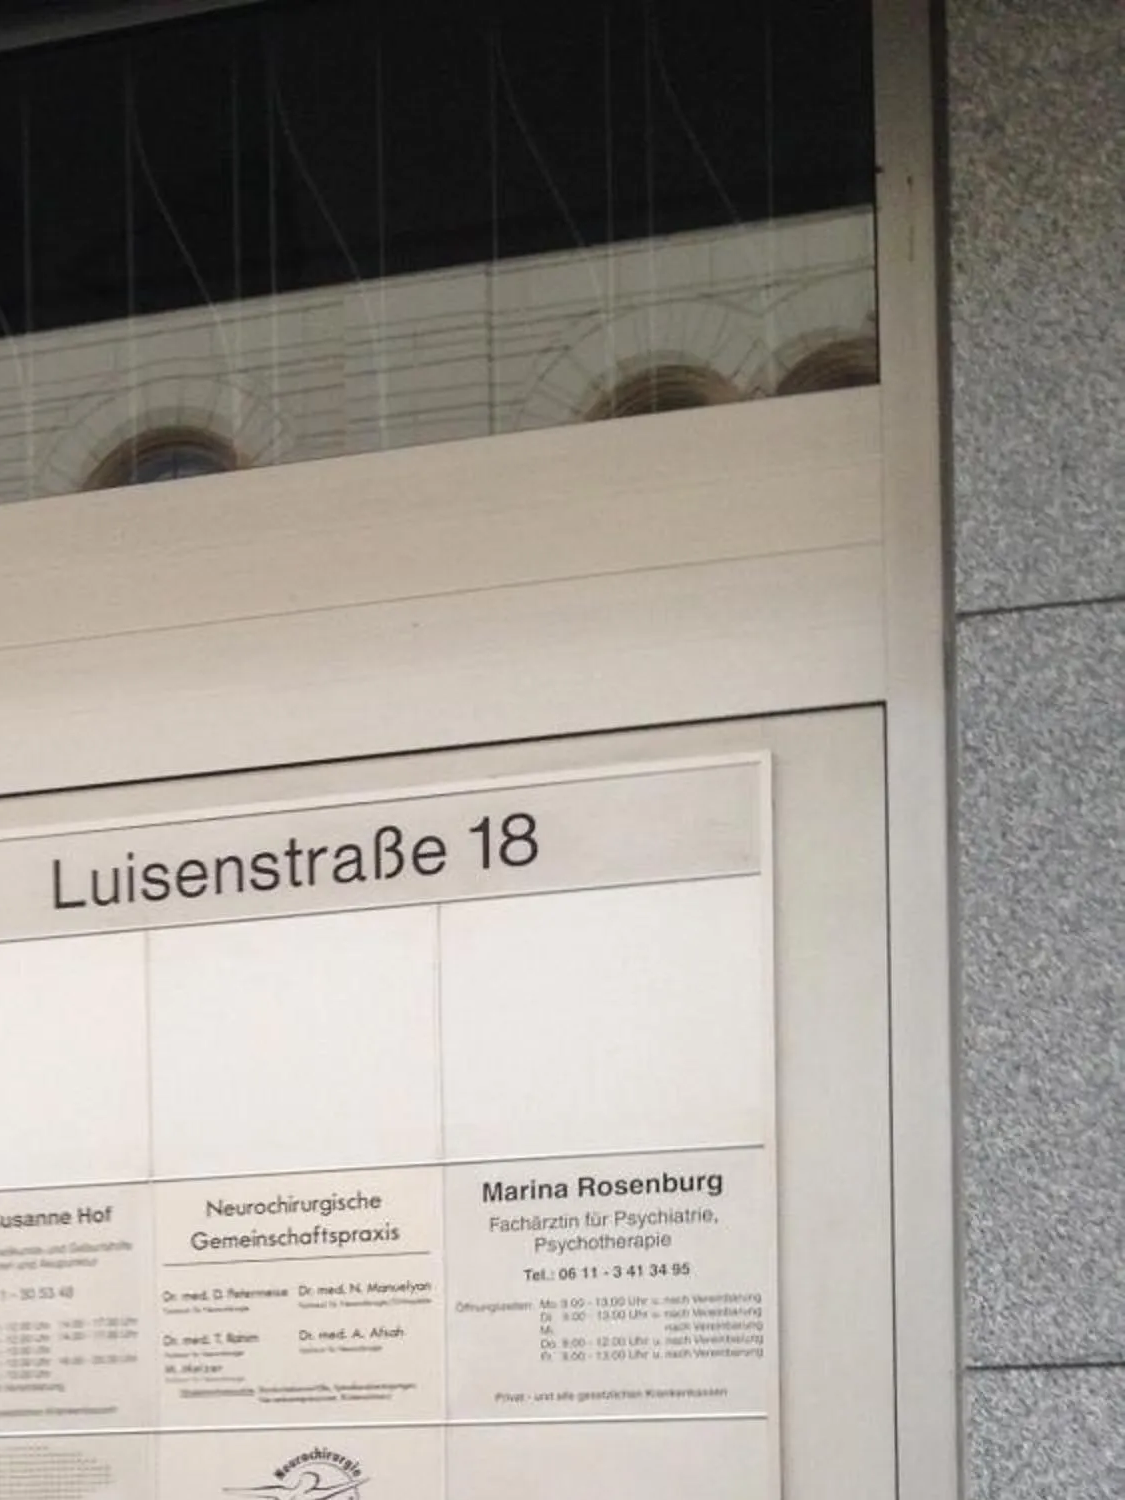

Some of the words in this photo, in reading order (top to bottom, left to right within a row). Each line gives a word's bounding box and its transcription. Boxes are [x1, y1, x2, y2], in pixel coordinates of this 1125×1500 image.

[52, 824, 447, 909] Luisenstraße
[469, 812, 539, 869] 18
[482, 1180, 568, 1203] Marina
[578, 1172, 723, 1198] Rosenburg
[77, 1206, 114, 1224] Hof
[205, 1189, 382, 1218] Neurochirurgische
[489, 1213, 580, 1233] Fachärztin
[585, 1210, 607, 1229] für
[614, 1206, 719, 1231] Psychiatrie,
[190, 1222, 401, 1251] Gemeinschaftspraxis
[534, 1232, 672, 1256] Psychotherapie
[524, 1268, 555, 1281] Tel.:
[558, 1267, 576, 1280] 06
[583, 1266, 598, 1279] 11
[613, 1265, 622, 1278] 3
[626, 1265, 644, 1277] 41
[649, 1263, 667, 1276] 34
